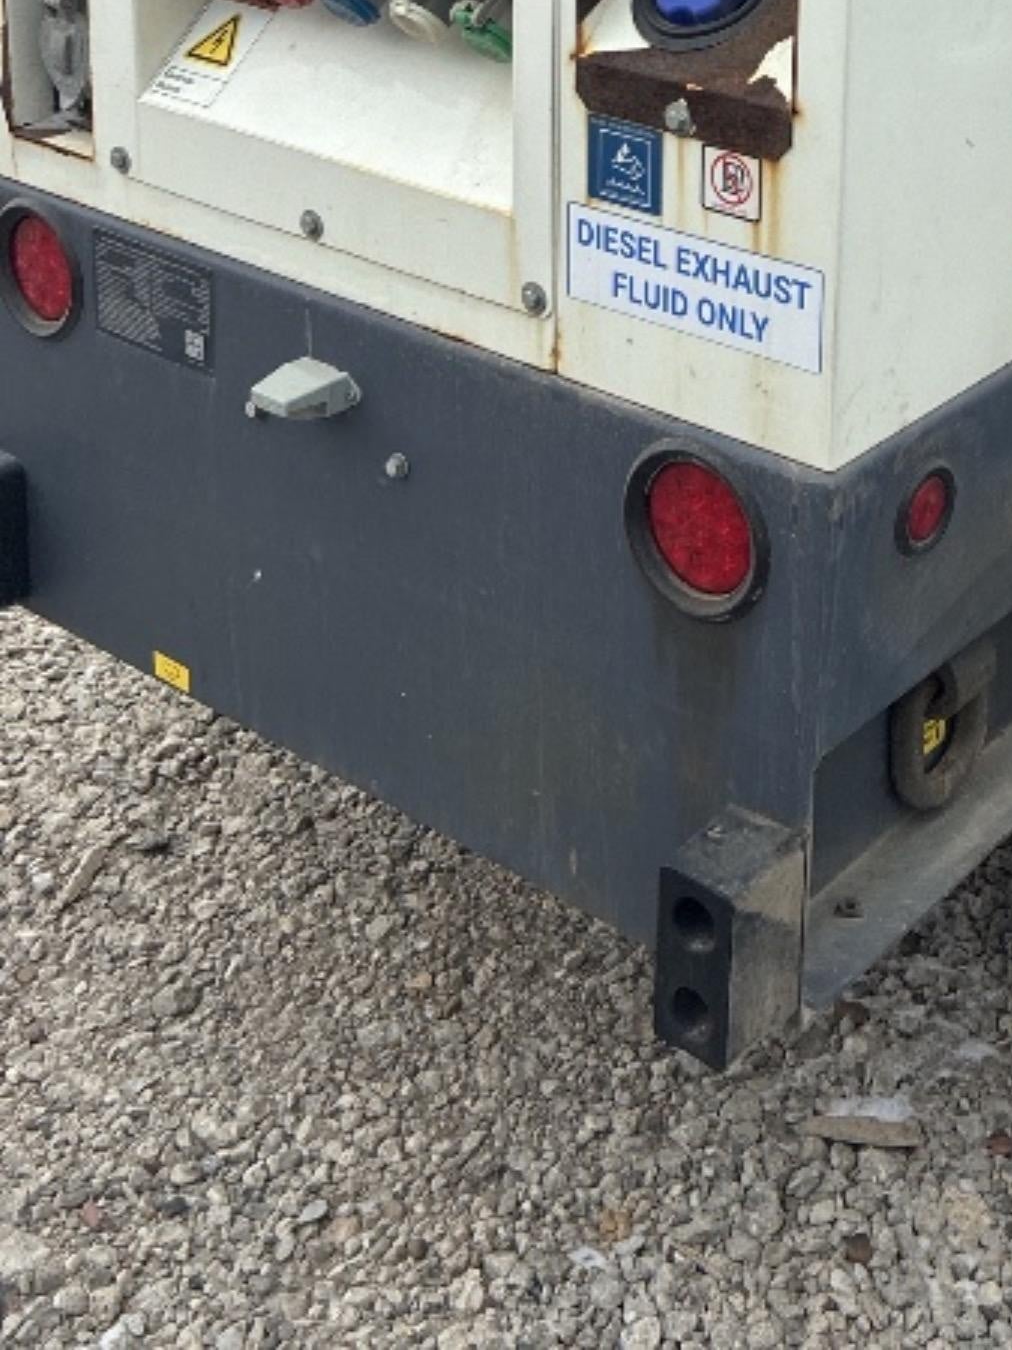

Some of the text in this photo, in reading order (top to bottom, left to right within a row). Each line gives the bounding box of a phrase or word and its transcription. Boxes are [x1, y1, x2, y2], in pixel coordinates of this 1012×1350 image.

[576, 217, 812, 310] DIESEL EXHAUST
[613, 271, 769, 343] FLUID ONLY
